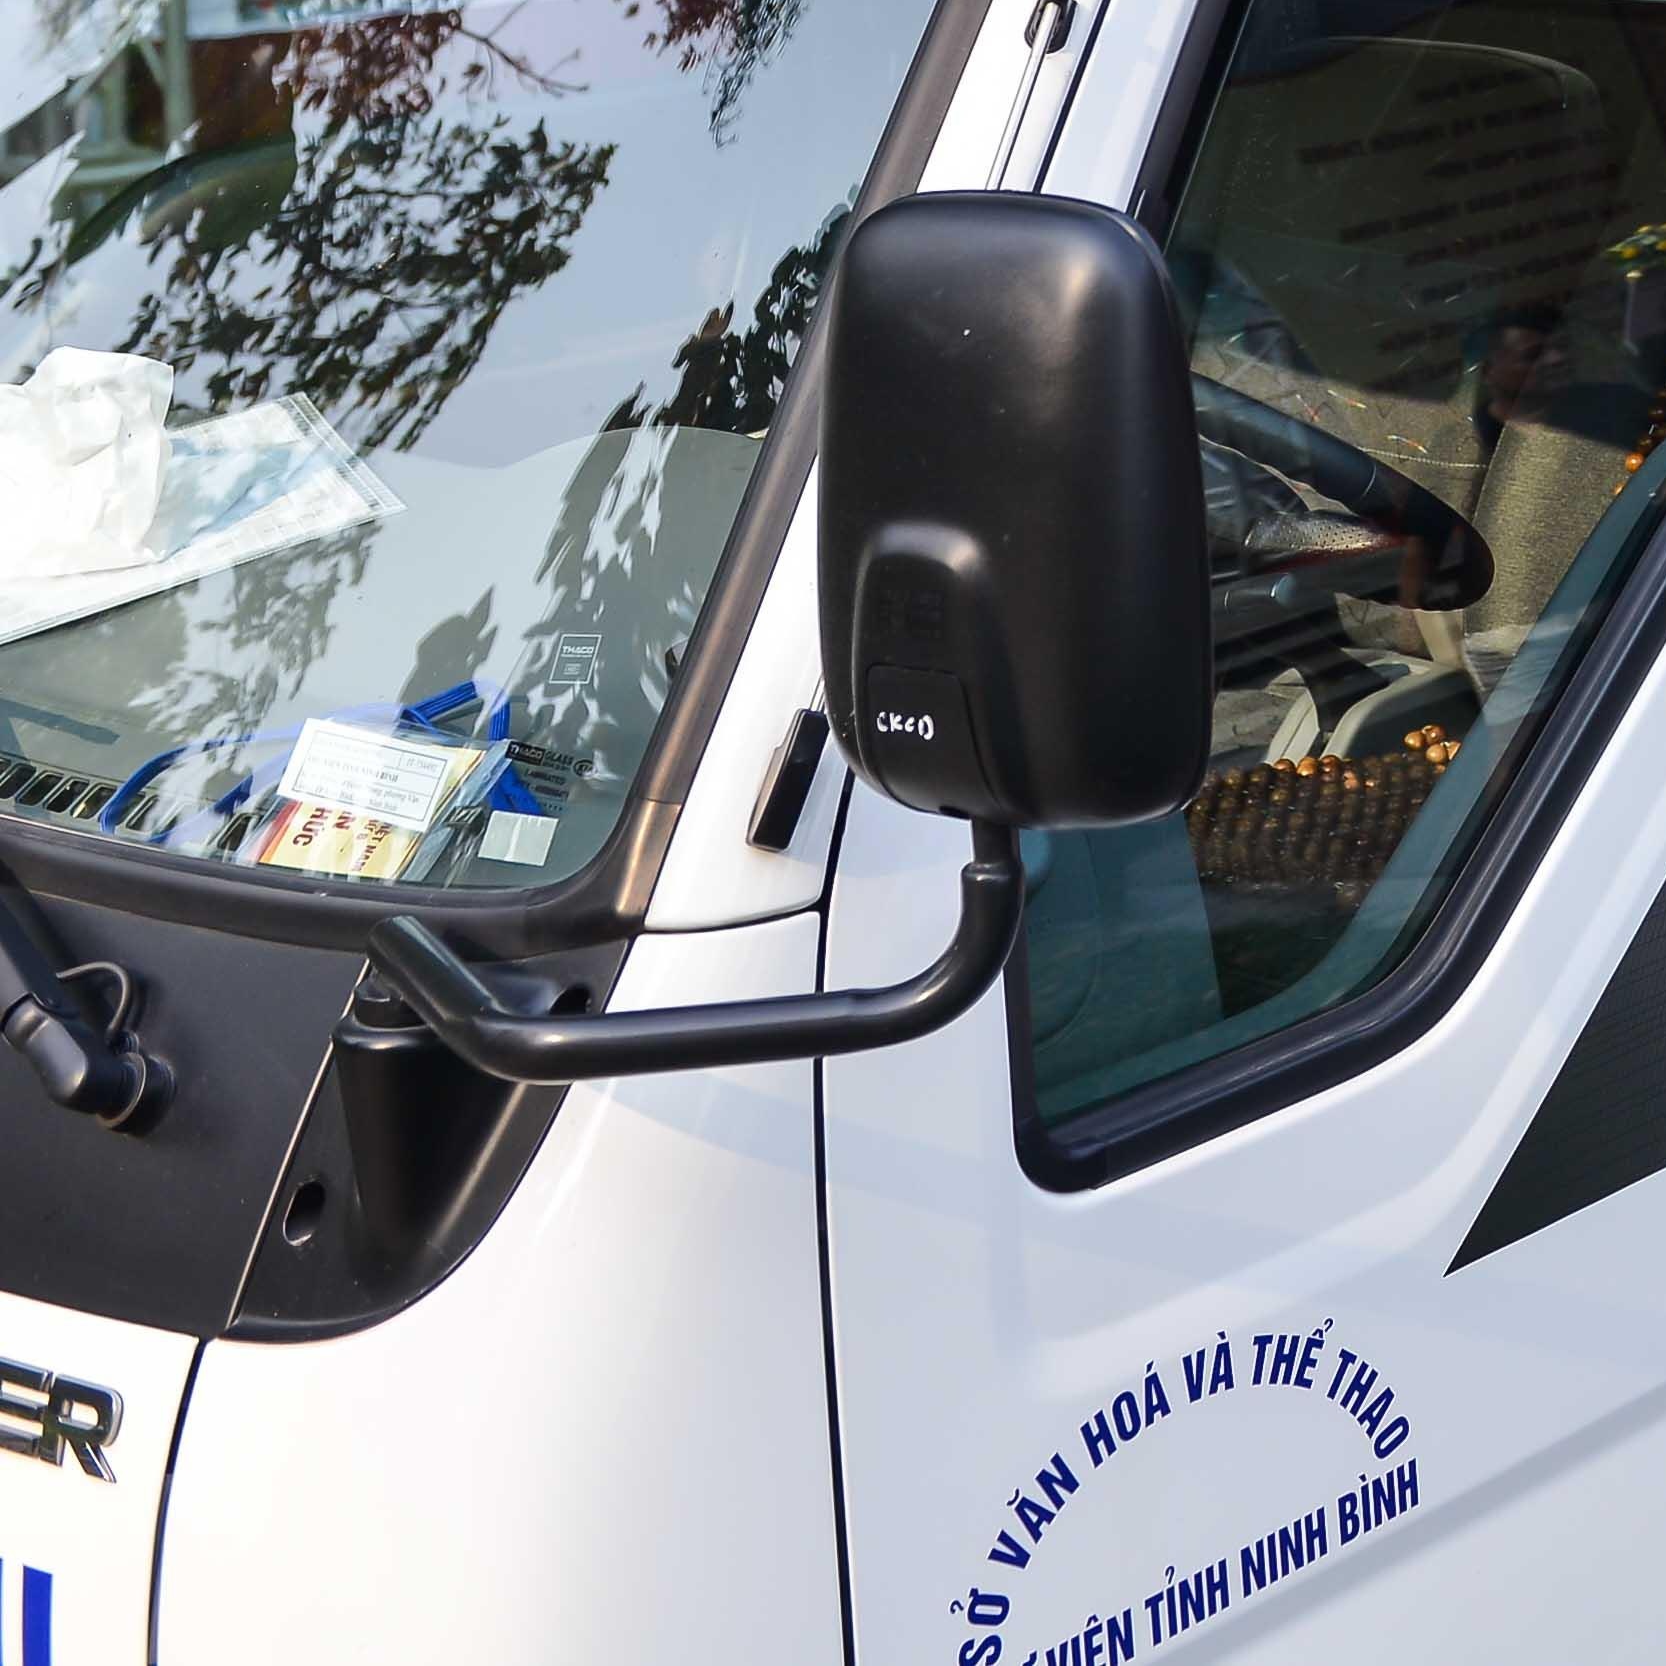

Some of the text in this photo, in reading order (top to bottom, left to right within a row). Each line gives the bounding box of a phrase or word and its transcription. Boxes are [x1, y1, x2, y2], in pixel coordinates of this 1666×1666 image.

[989, 1454, 1079, 1568] VĂN
[1081, 1363, 1170, 1466] HOÁ
[1183, 1332, 1234, 1401] VÀ
[1252, 1318, 1334, 1388] THỂ
[1328, 1350, 1409, 1458] THAO
[1145, 1559, 1229, 1645] TỈNH
[1241, 1507, 1328, 1597] NINH
[1338, 1460, 1419, 1544] BÌNH
